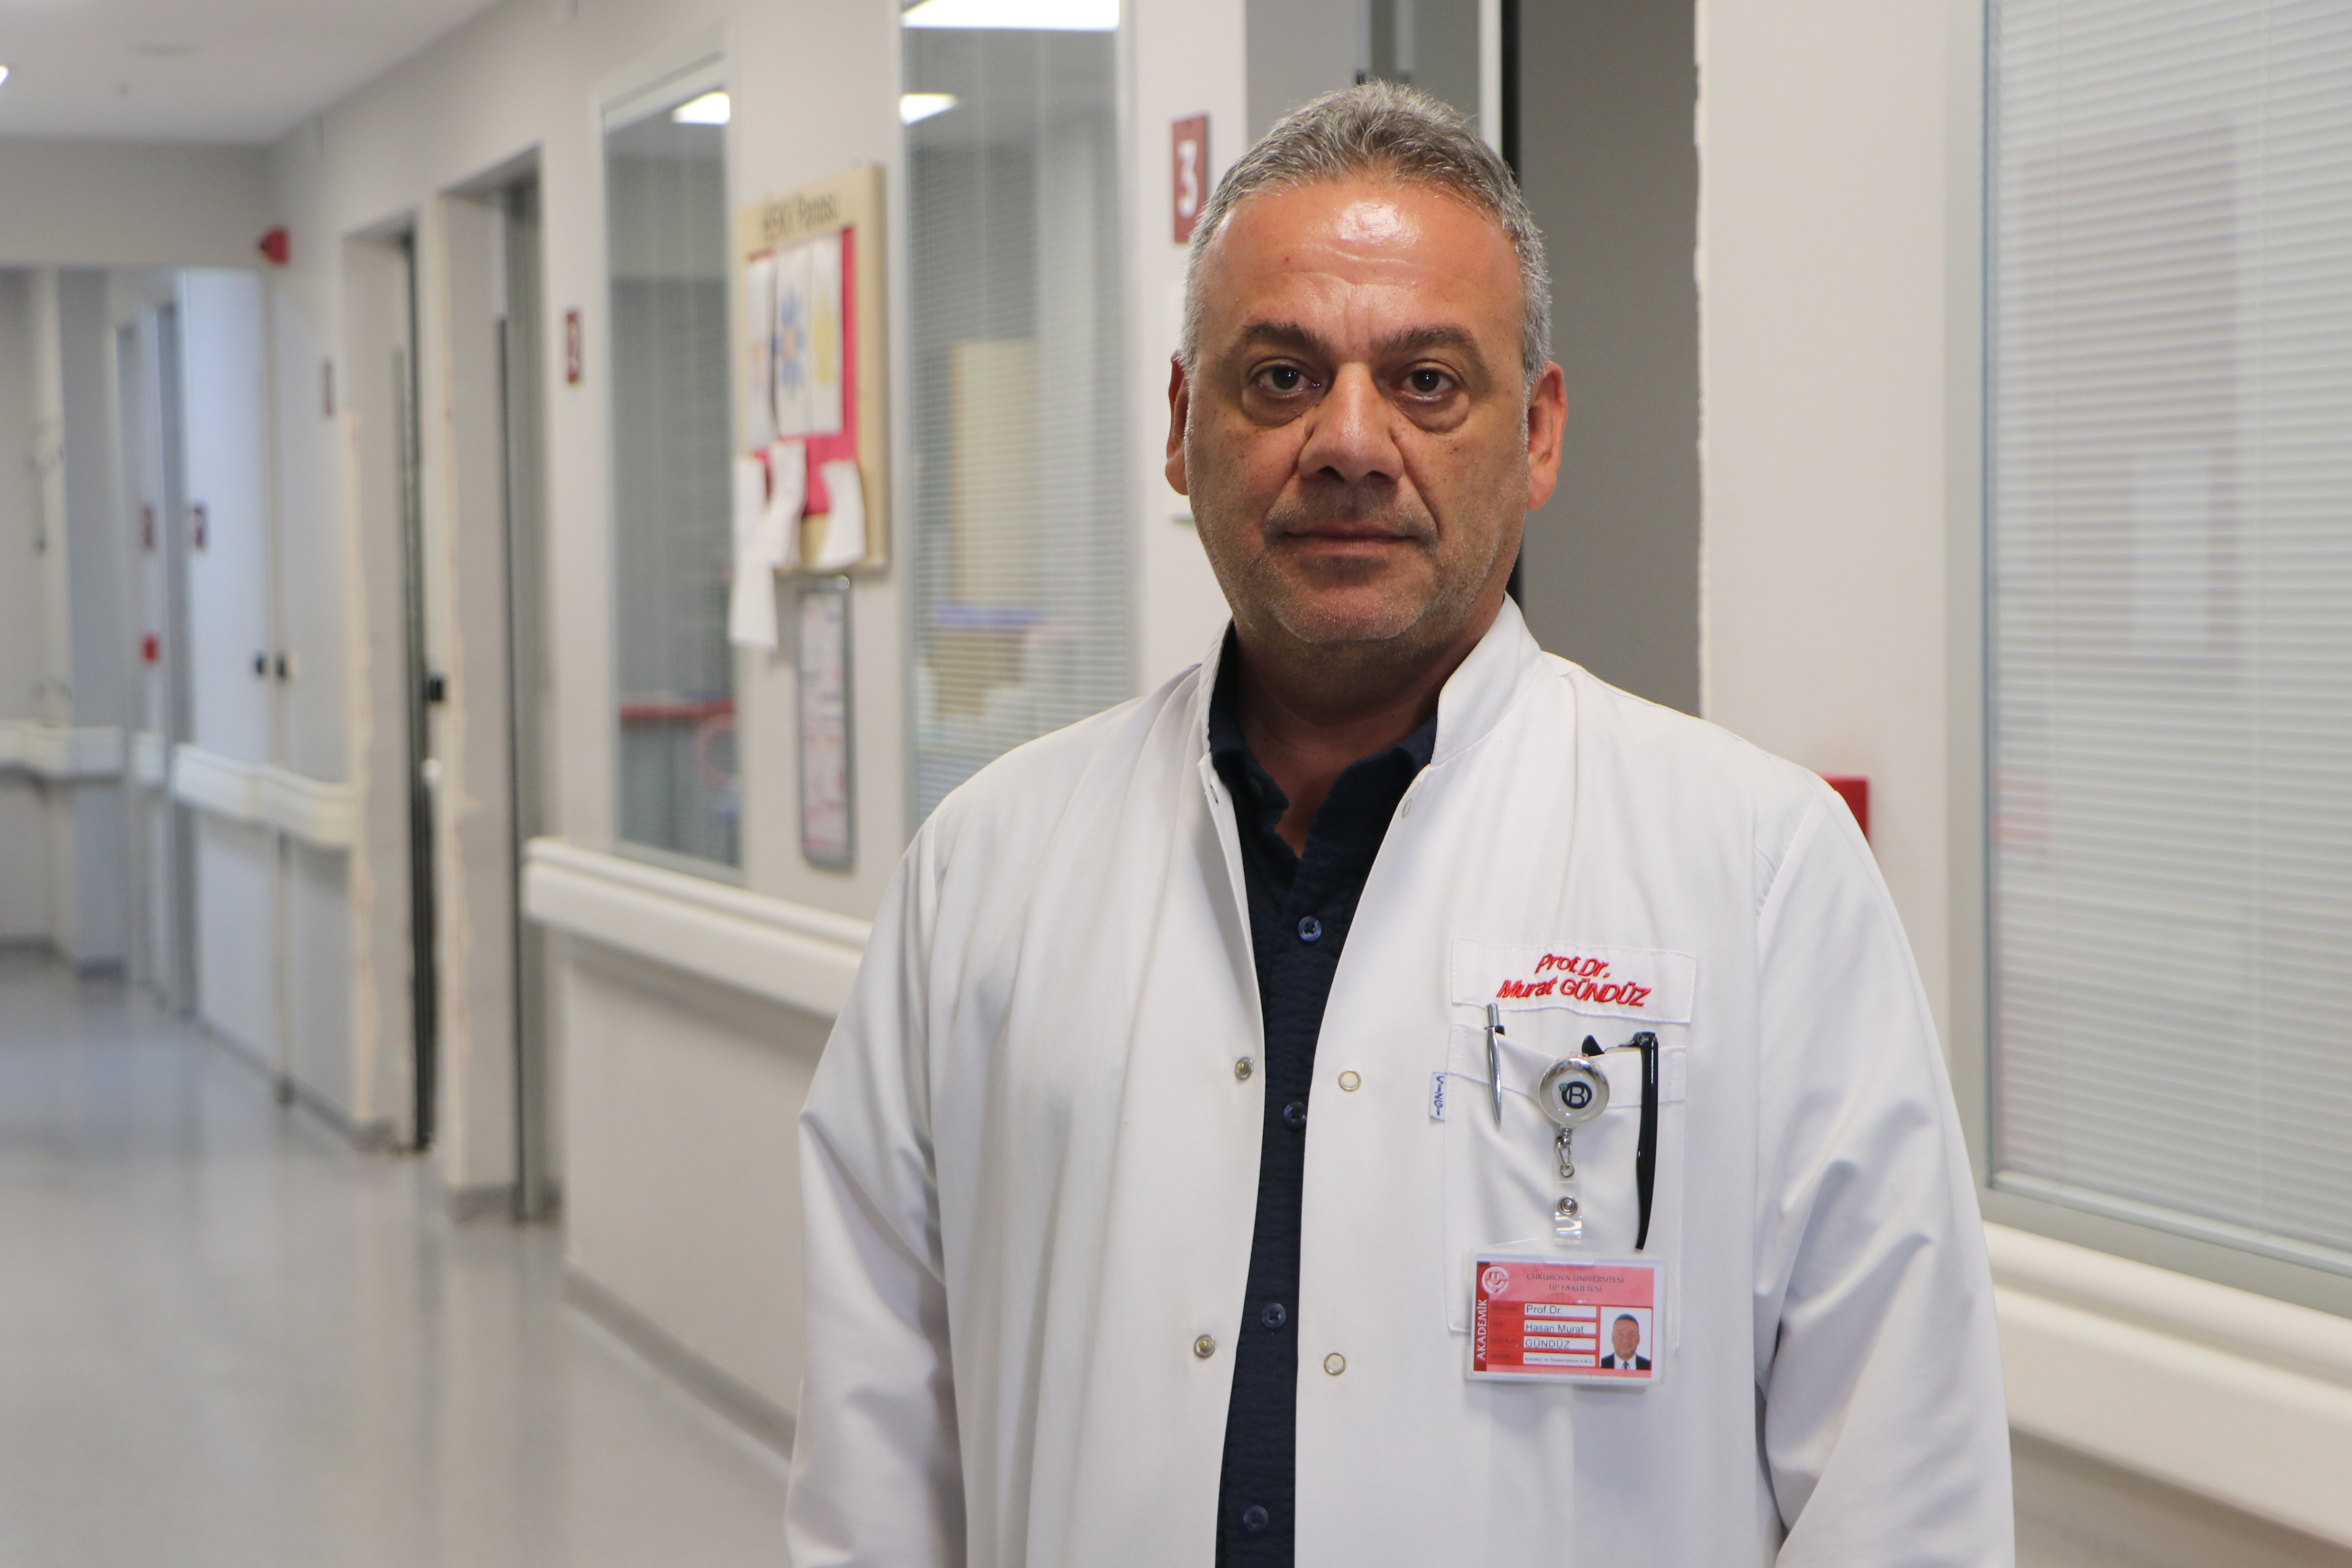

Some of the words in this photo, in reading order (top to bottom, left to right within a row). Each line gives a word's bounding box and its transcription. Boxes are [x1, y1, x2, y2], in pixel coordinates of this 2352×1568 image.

[1178, 139, 1198, 218] 3
[1496, 976, 1558, 998] Murat
[1560, 978, 1651, 1007] GÜNDÜZ
[1477, 1299, 1487, 1360] AKADEMİK
[1525, 1338, 1570, 1348] GÜNDÜZ
[1526, 1323, 1554, 1332] Hasan
[1558, 1325, 1584, 1333] Murat
